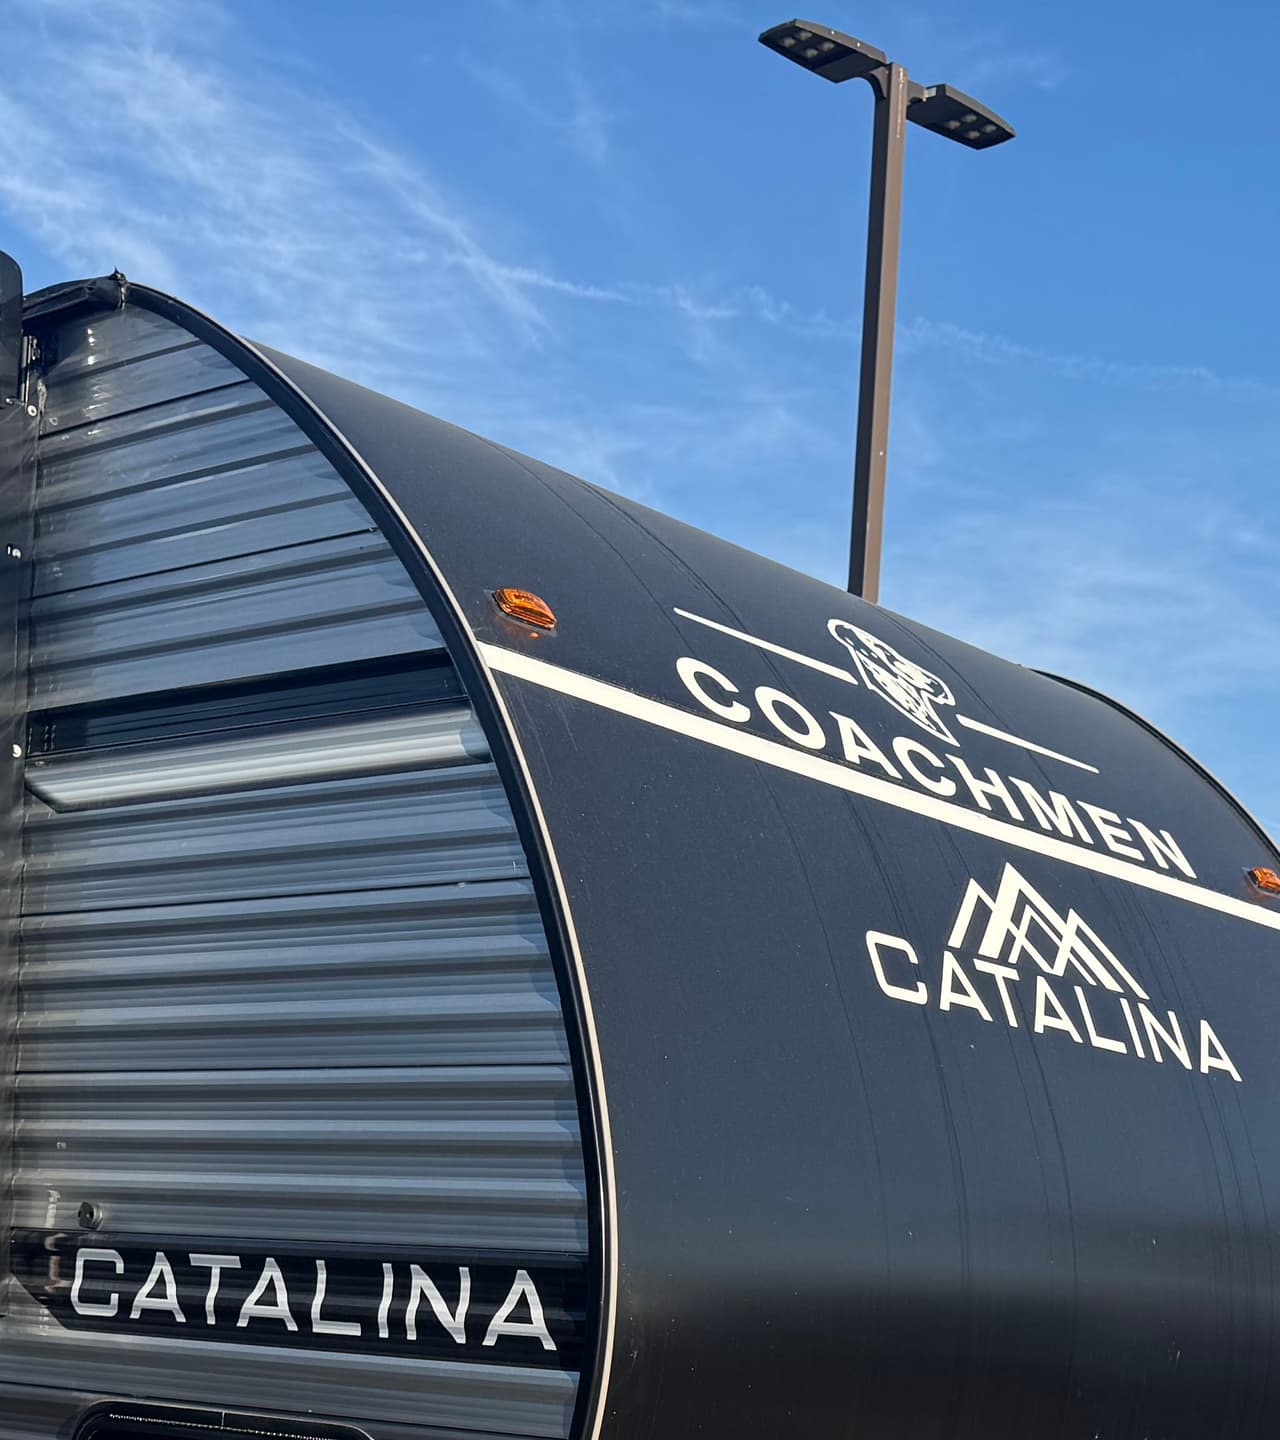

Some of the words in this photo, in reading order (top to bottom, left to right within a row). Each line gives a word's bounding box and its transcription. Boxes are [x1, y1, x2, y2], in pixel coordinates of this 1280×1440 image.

[676, 656, 1197, 879] COACHMEN
[865, 930, 1243, 1082] CATALINA
[70, 1247, 558, 1351] CATALINA
